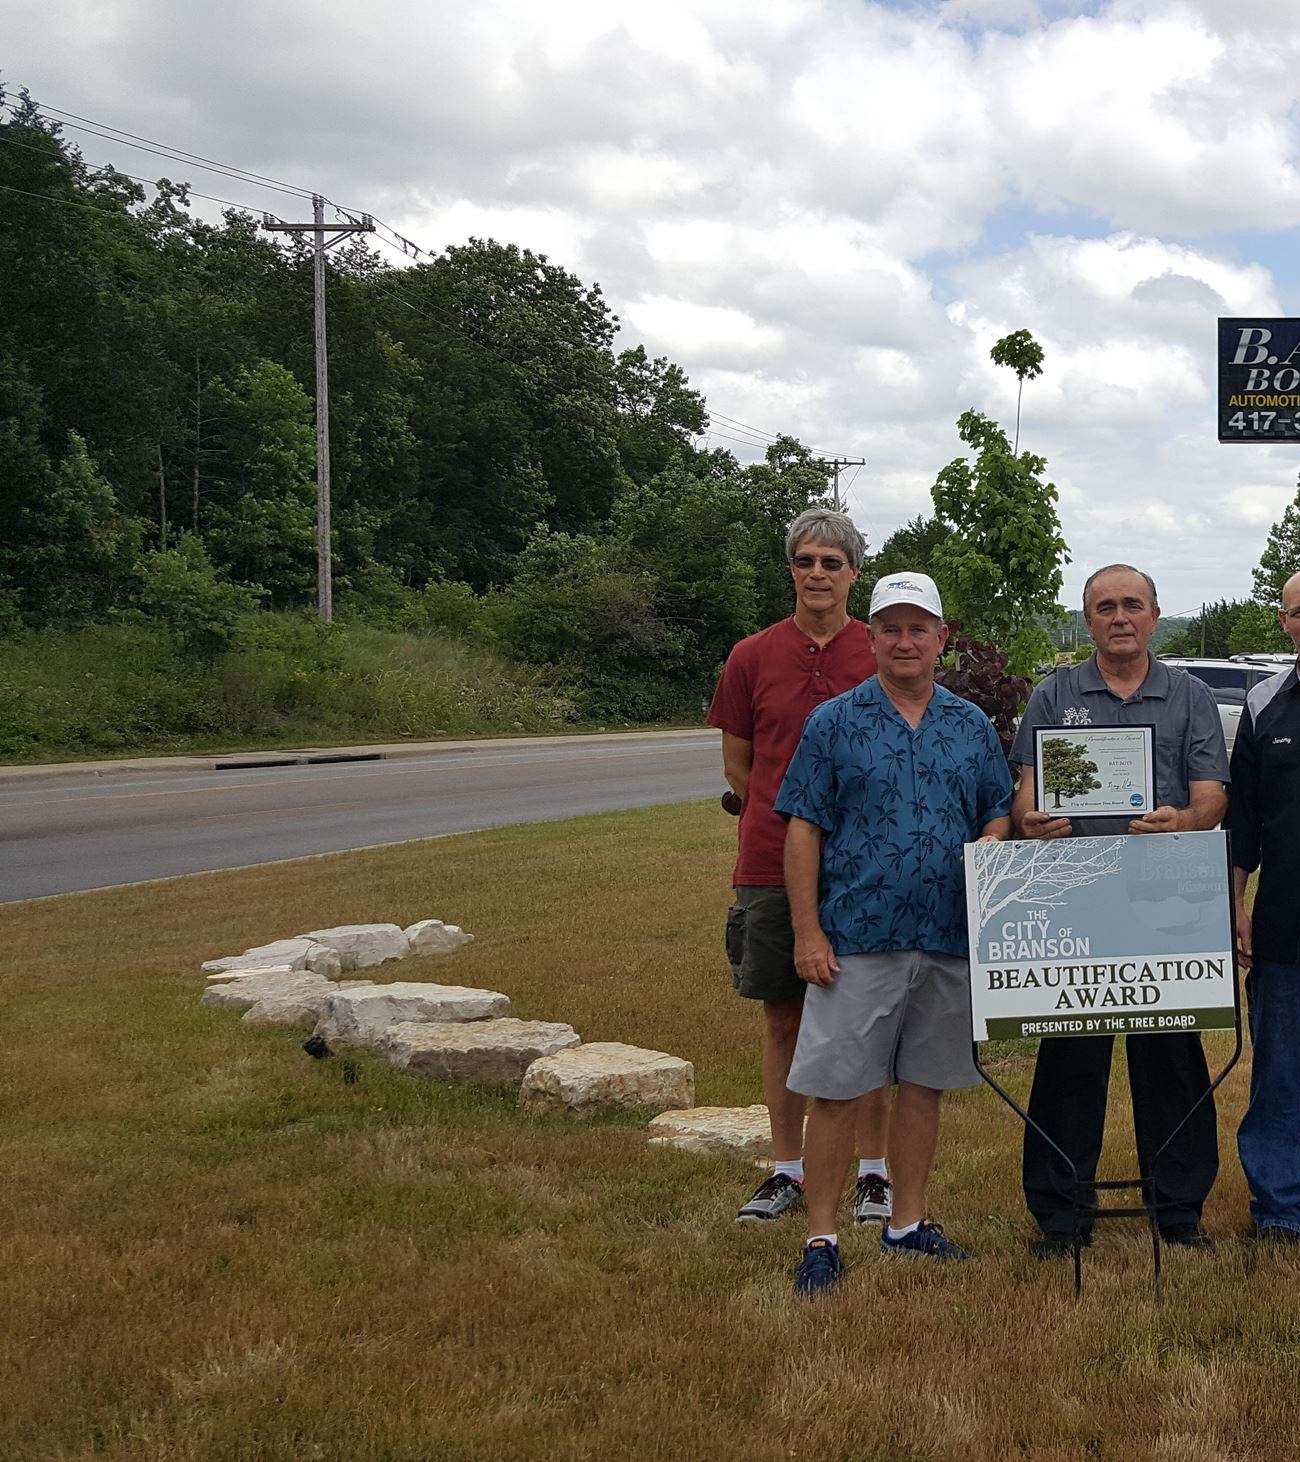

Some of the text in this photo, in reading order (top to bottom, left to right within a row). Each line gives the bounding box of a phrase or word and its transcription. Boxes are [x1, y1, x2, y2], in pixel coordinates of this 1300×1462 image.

[1027, 909, 1047, 920] THE
[1002, 920, 1073, 941] CITY OF
[988, 937, 1090, 961] BRANSON
[987, 958, 1225, 990] BEAUTIFICATION
[1054, 985, 1161, 1009] AWARD
[1021, 1015, 1196, 1034] PRESENTED BY THE TREE BOARD
